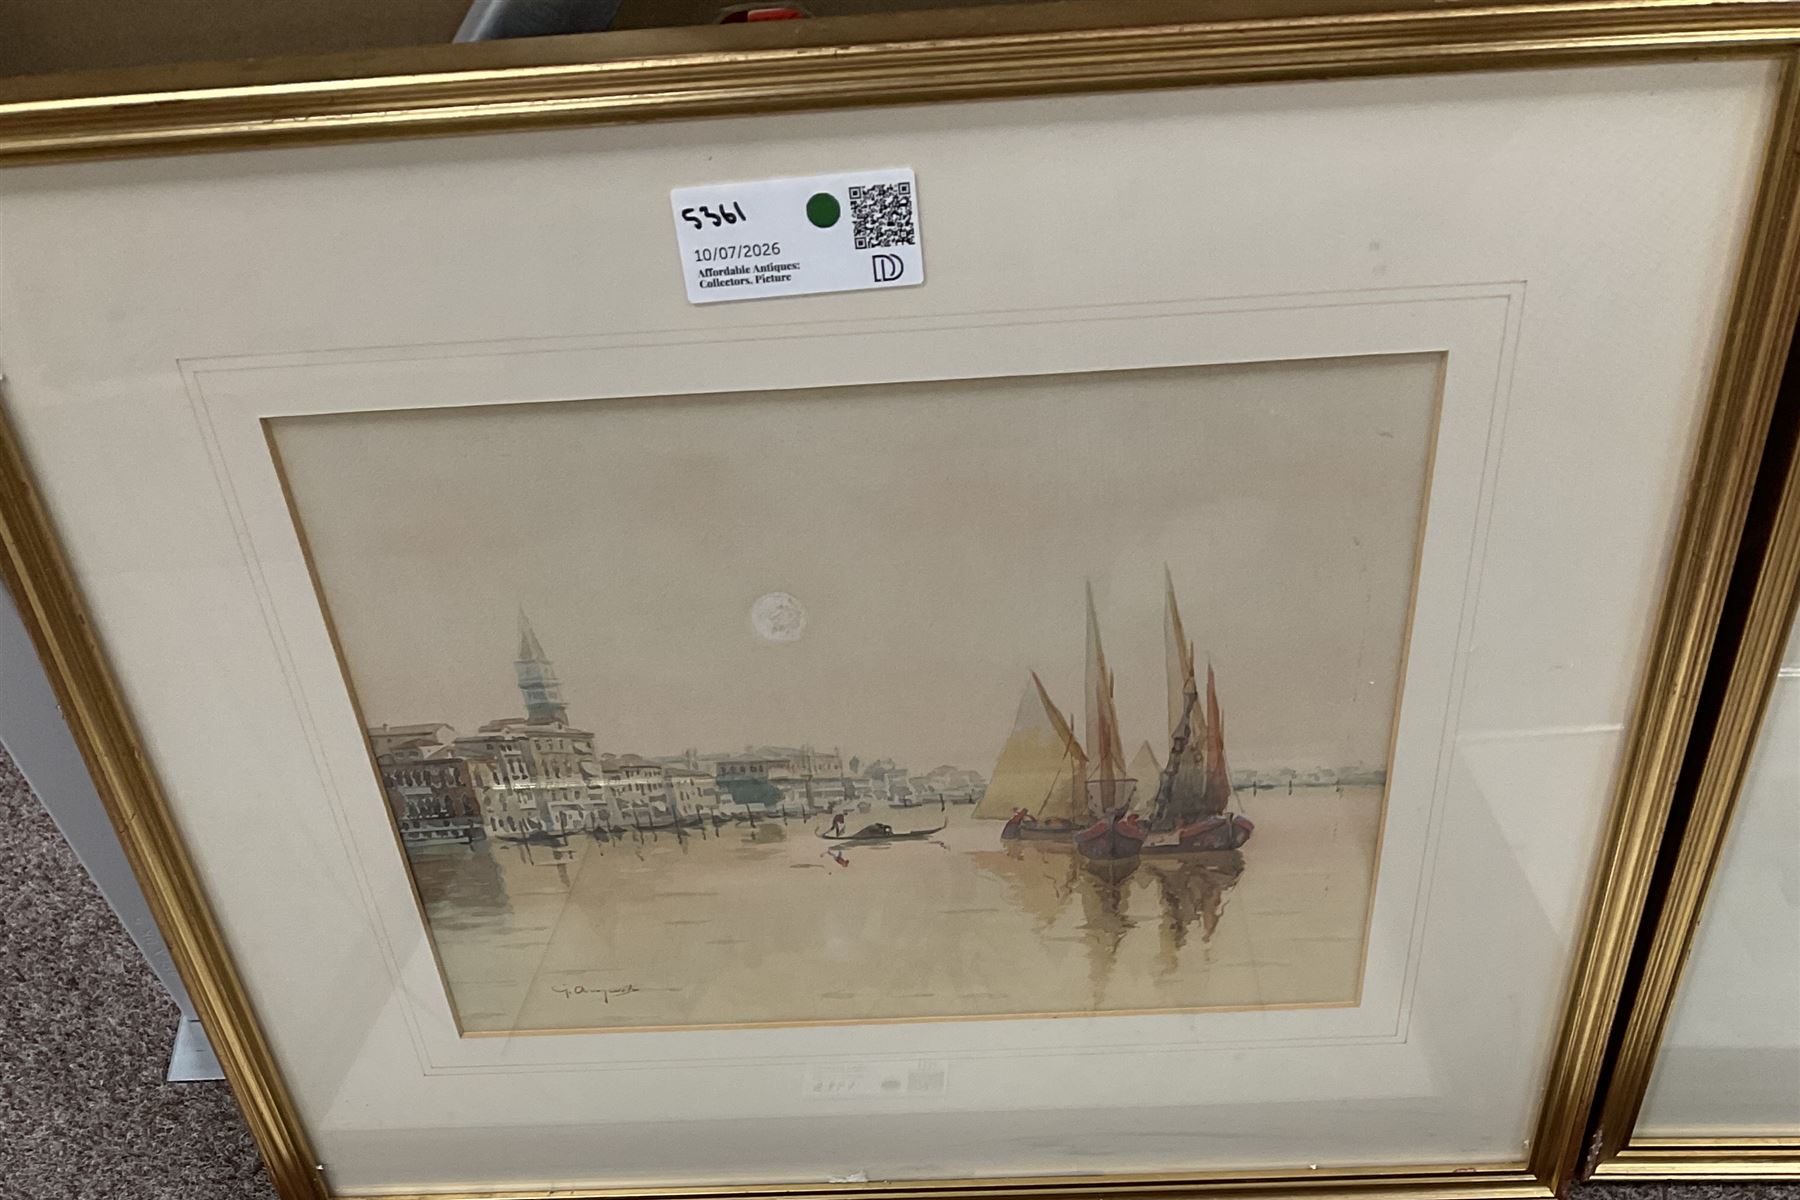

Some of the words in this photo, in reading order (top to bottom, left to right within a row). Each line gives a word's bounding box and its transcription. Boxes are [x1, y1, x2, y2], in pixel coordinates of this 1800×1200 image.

[682, 201, 747, 230] 5361
[694, 242, 781, 262] 10/07/2026
[698, 264, 751, 278] Affordable
[755, 274, 792, 284] Picture
